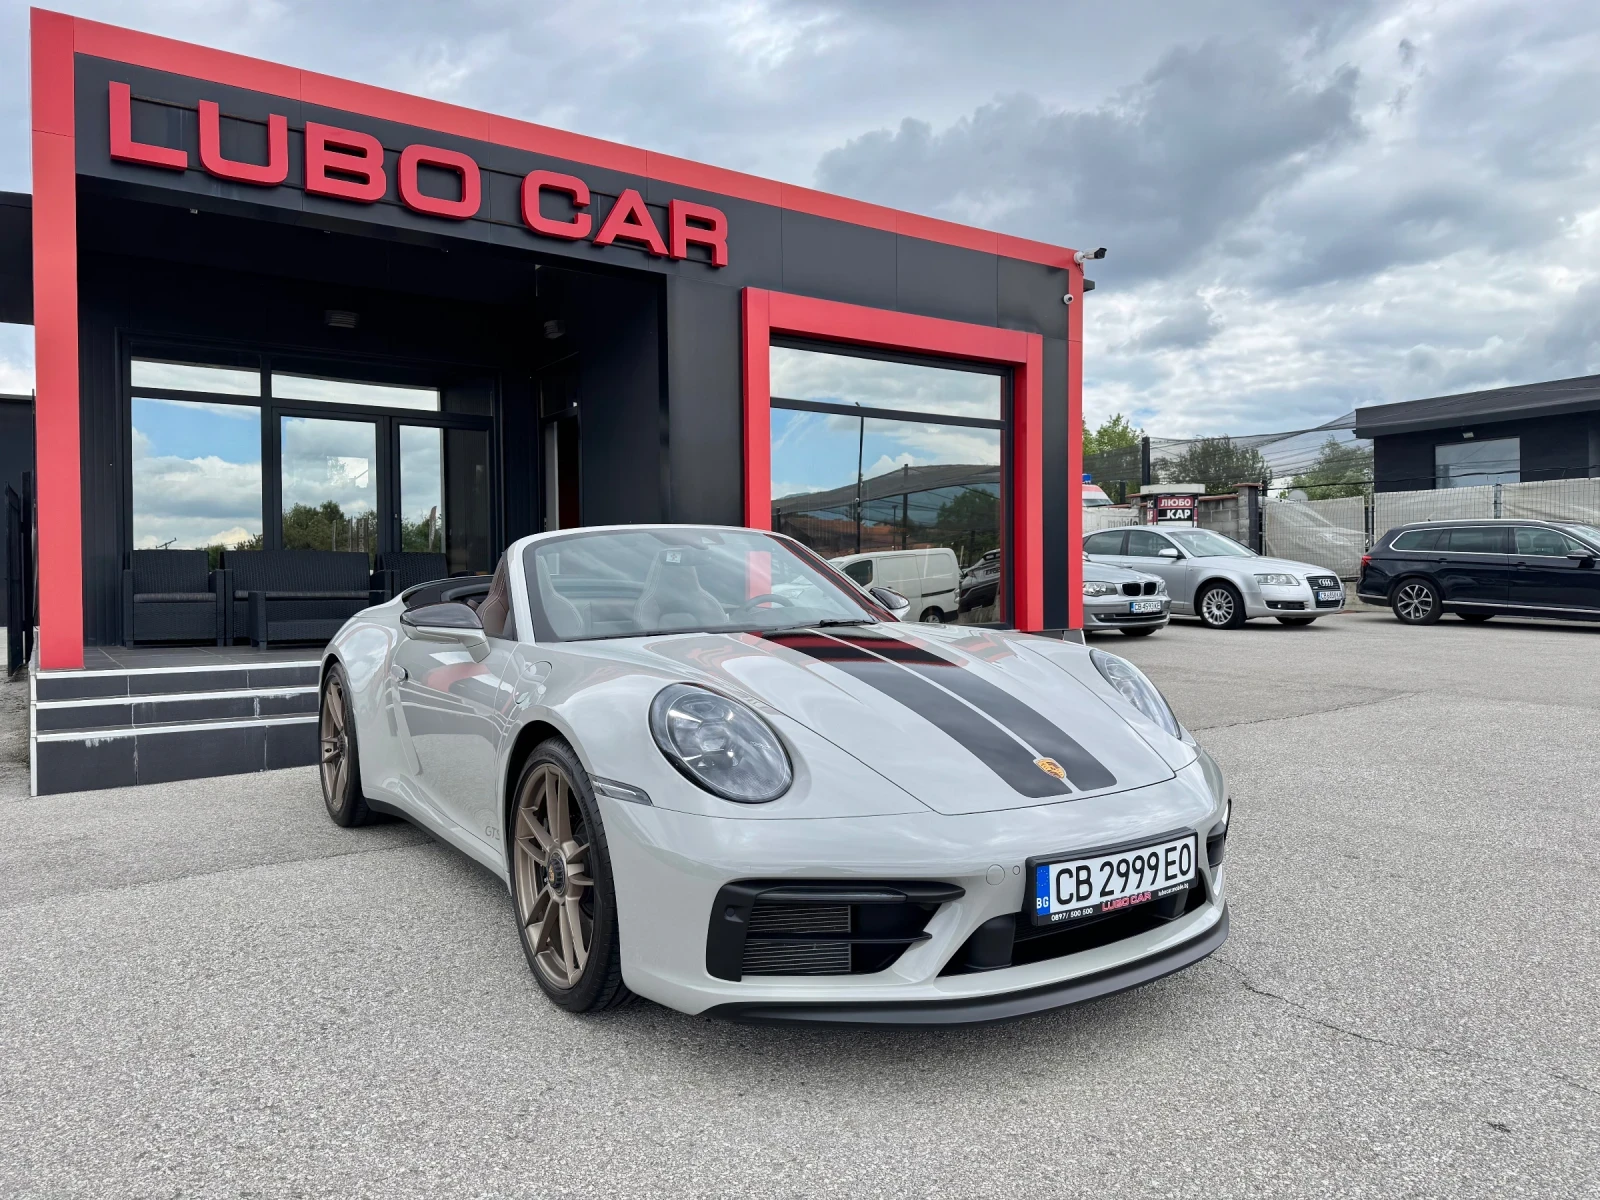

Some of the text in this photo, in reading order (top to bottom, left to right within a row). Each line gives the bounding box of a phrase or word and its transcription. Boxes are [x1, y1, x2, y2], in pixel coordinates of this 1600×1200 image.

[109, 81, 728, 267] LUBO CAR
[1160, 498, 1191, 507] ЛЮБО
[1167, 509, 1191, 519] КАР
[485, 826, 500, 840] GTS
[1056, 843, 1192, 906] CB 2999 EO
[1036, 896, 1049, 909] BG
[1101, 891, 1152, 912] LUBO CAR
[1051, 907, 1093, 921] 0897/ 500 500
